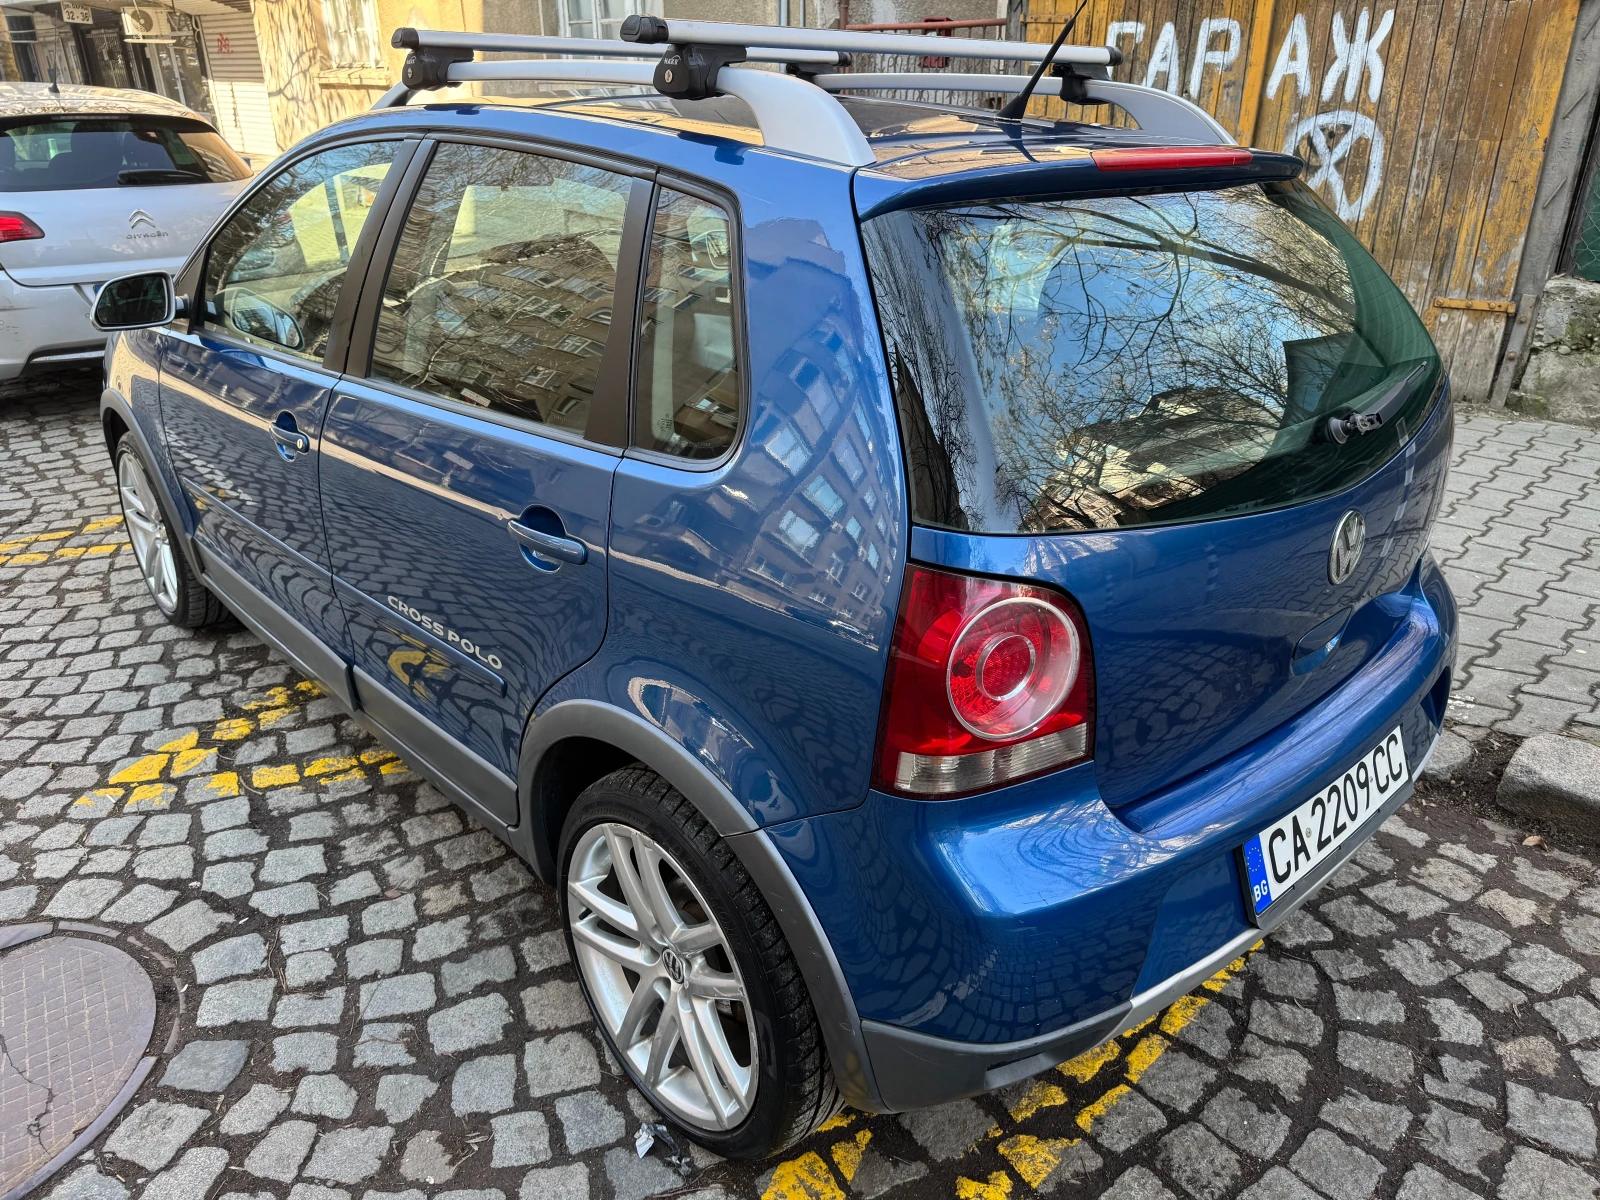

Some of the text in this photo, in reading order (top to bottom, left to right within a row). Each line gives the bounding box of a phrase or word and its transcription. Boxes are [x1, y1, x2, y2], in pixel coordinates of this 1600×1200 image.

[387, 595, 503, 670] CROSS POLO
[1311, 761, 1370, 852] 2209
[1253, 879, 1268, 902] BG
